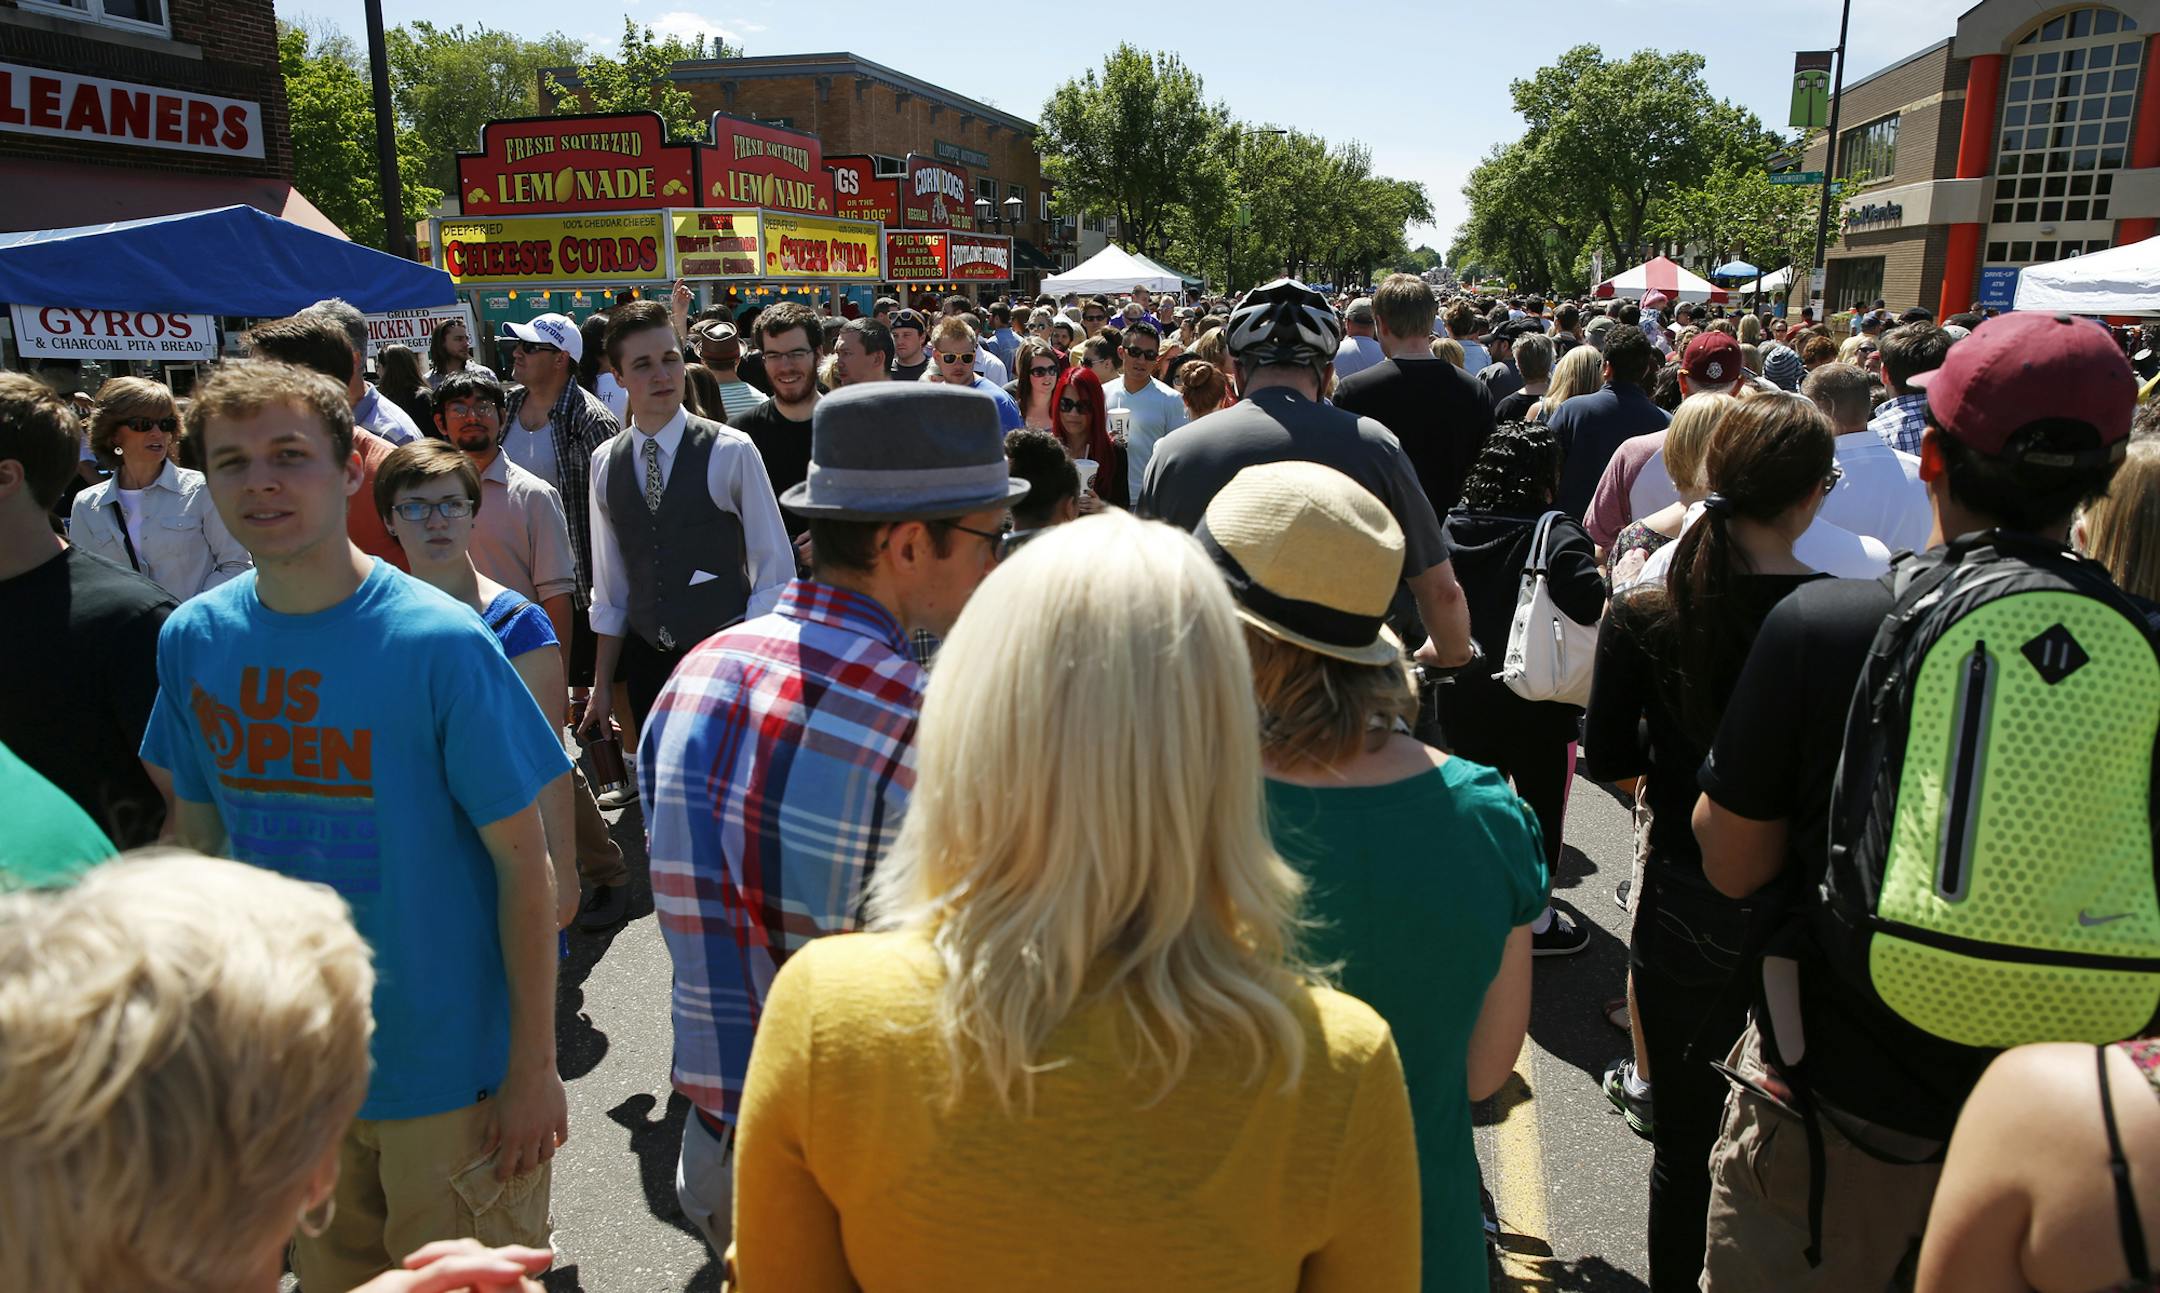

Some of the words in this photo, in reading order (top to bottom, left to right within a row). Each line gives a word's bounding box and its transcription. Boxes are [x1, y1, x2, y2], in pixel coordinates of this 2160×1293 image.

[505, 136, 555, 164] FRESH
[560, 132, 642, 157] SQUEEZED
[732, 134, 764, 161] FRESH
[766, 141, 809, 173] SQUEEZED
[914, 167, 940, 196] CORN
[941, 168, 965, 204] DOGS
[443, 223, 503, 236] DEEP-FRIED
[562, 219, 583, 229] 100%
[584, 218, 622, 228] CHEDDAR
[623, 217, 656, 227] CHEESE
[446, 239, 554, 277] CHEESE
[558, 236, 658, 274] CURDS
[894, 256, 914, 266] ALL
[915, 256, 941, 266] BEEF
[892, 267, 943, 278] CORNDOGS
[39, 306, 193, 339] GYROS
[387, 309, 430, 319] GRILLED
[368, 319, 414, 340] HICKEN
[533, 319, 566, 344] Corona
[36, 337, 46, 349] &
[52, 337, 123, 351] CHARCOAL
[128, 340, 156, 351] PITA
[161, 341, 204, 352] BREAD
[239, 666, 322, 723] US
